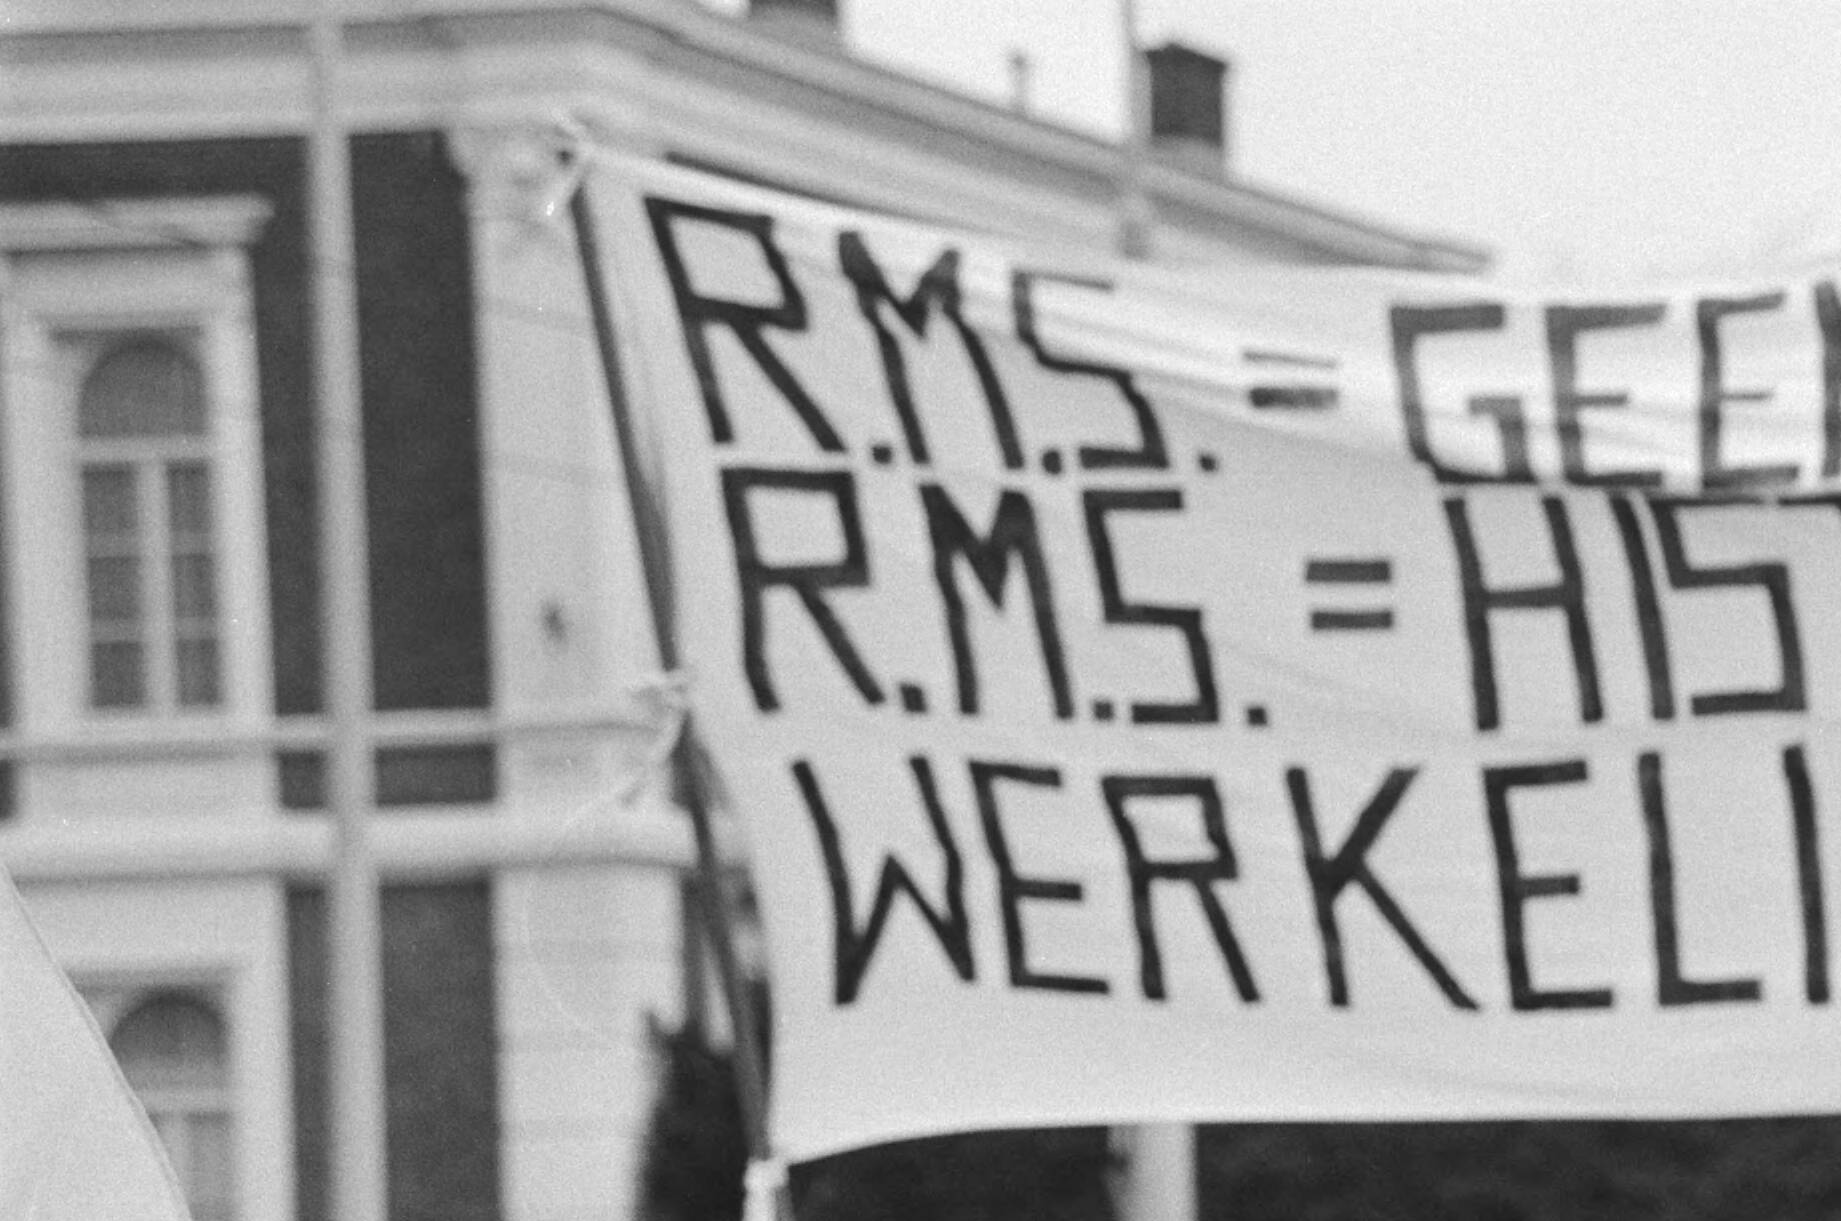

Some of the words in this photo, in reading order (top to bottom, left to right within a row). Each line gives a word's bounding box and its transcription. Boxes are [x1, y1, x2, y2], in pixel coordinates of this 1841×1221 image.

[644, 195, 1221, 475] R.M.S.
[1240, 349, 1339, 410] =
[720, 466, 1269, 727] R.M.S.
[1305, 559, 1393, 630] =
